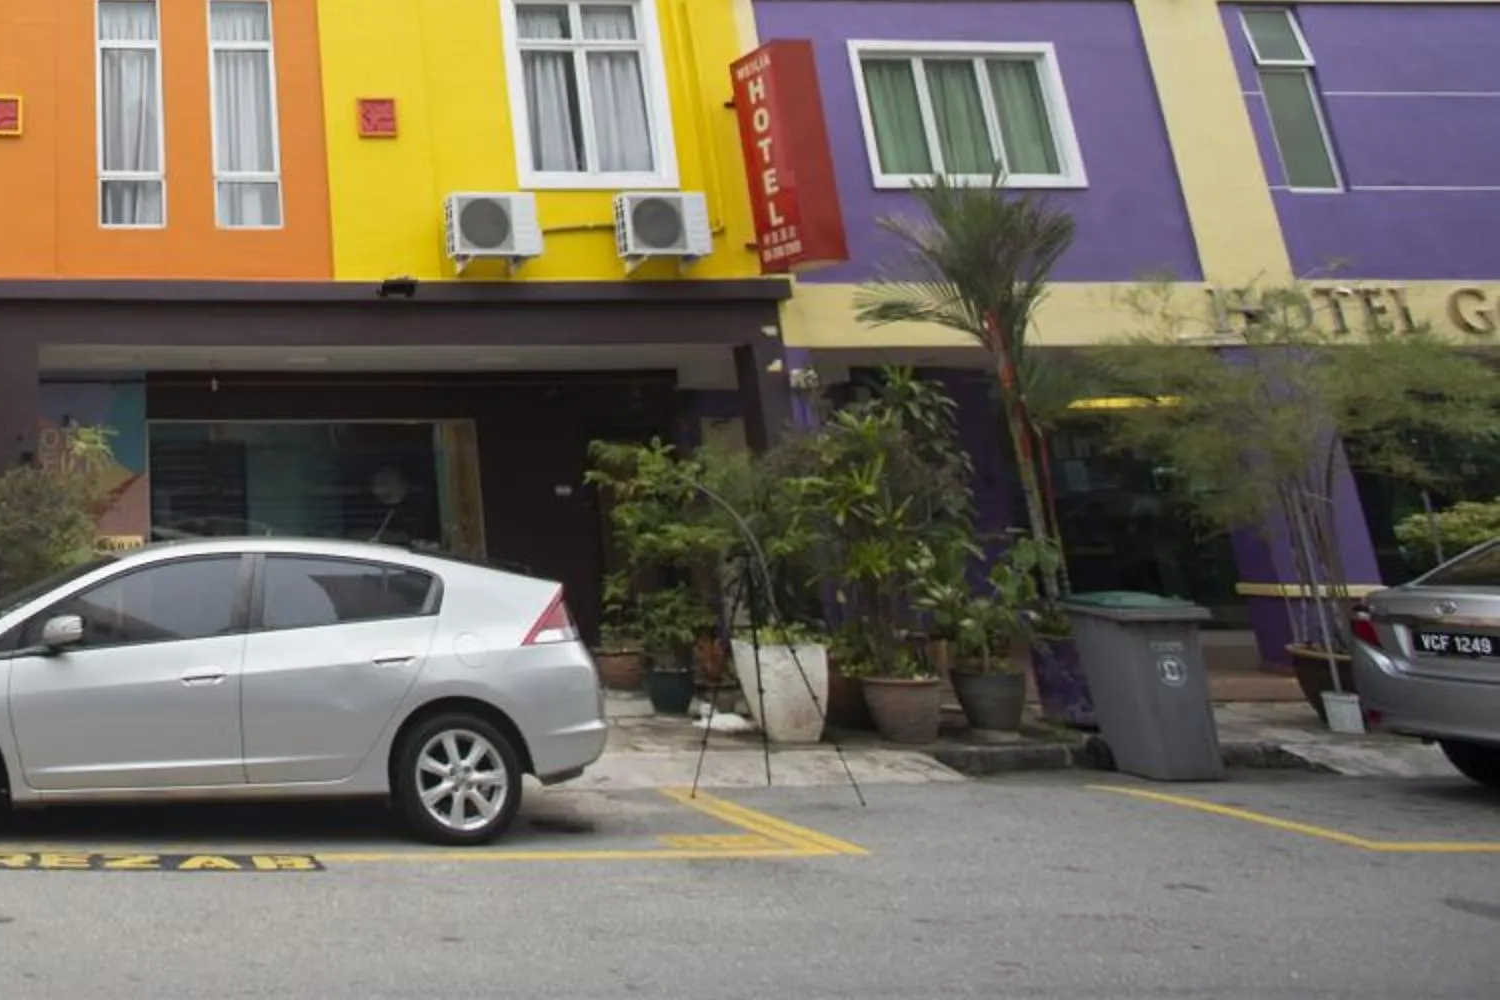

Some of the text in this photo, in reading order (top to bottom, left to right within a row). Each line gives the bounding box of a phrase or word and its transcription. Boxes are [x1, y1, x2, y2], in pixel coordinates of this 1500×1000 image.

[748, 74, 785, 227] HOTEL
[1446, 287, 1500, 335] G
[1454, 635, 1492, 654] 1249
